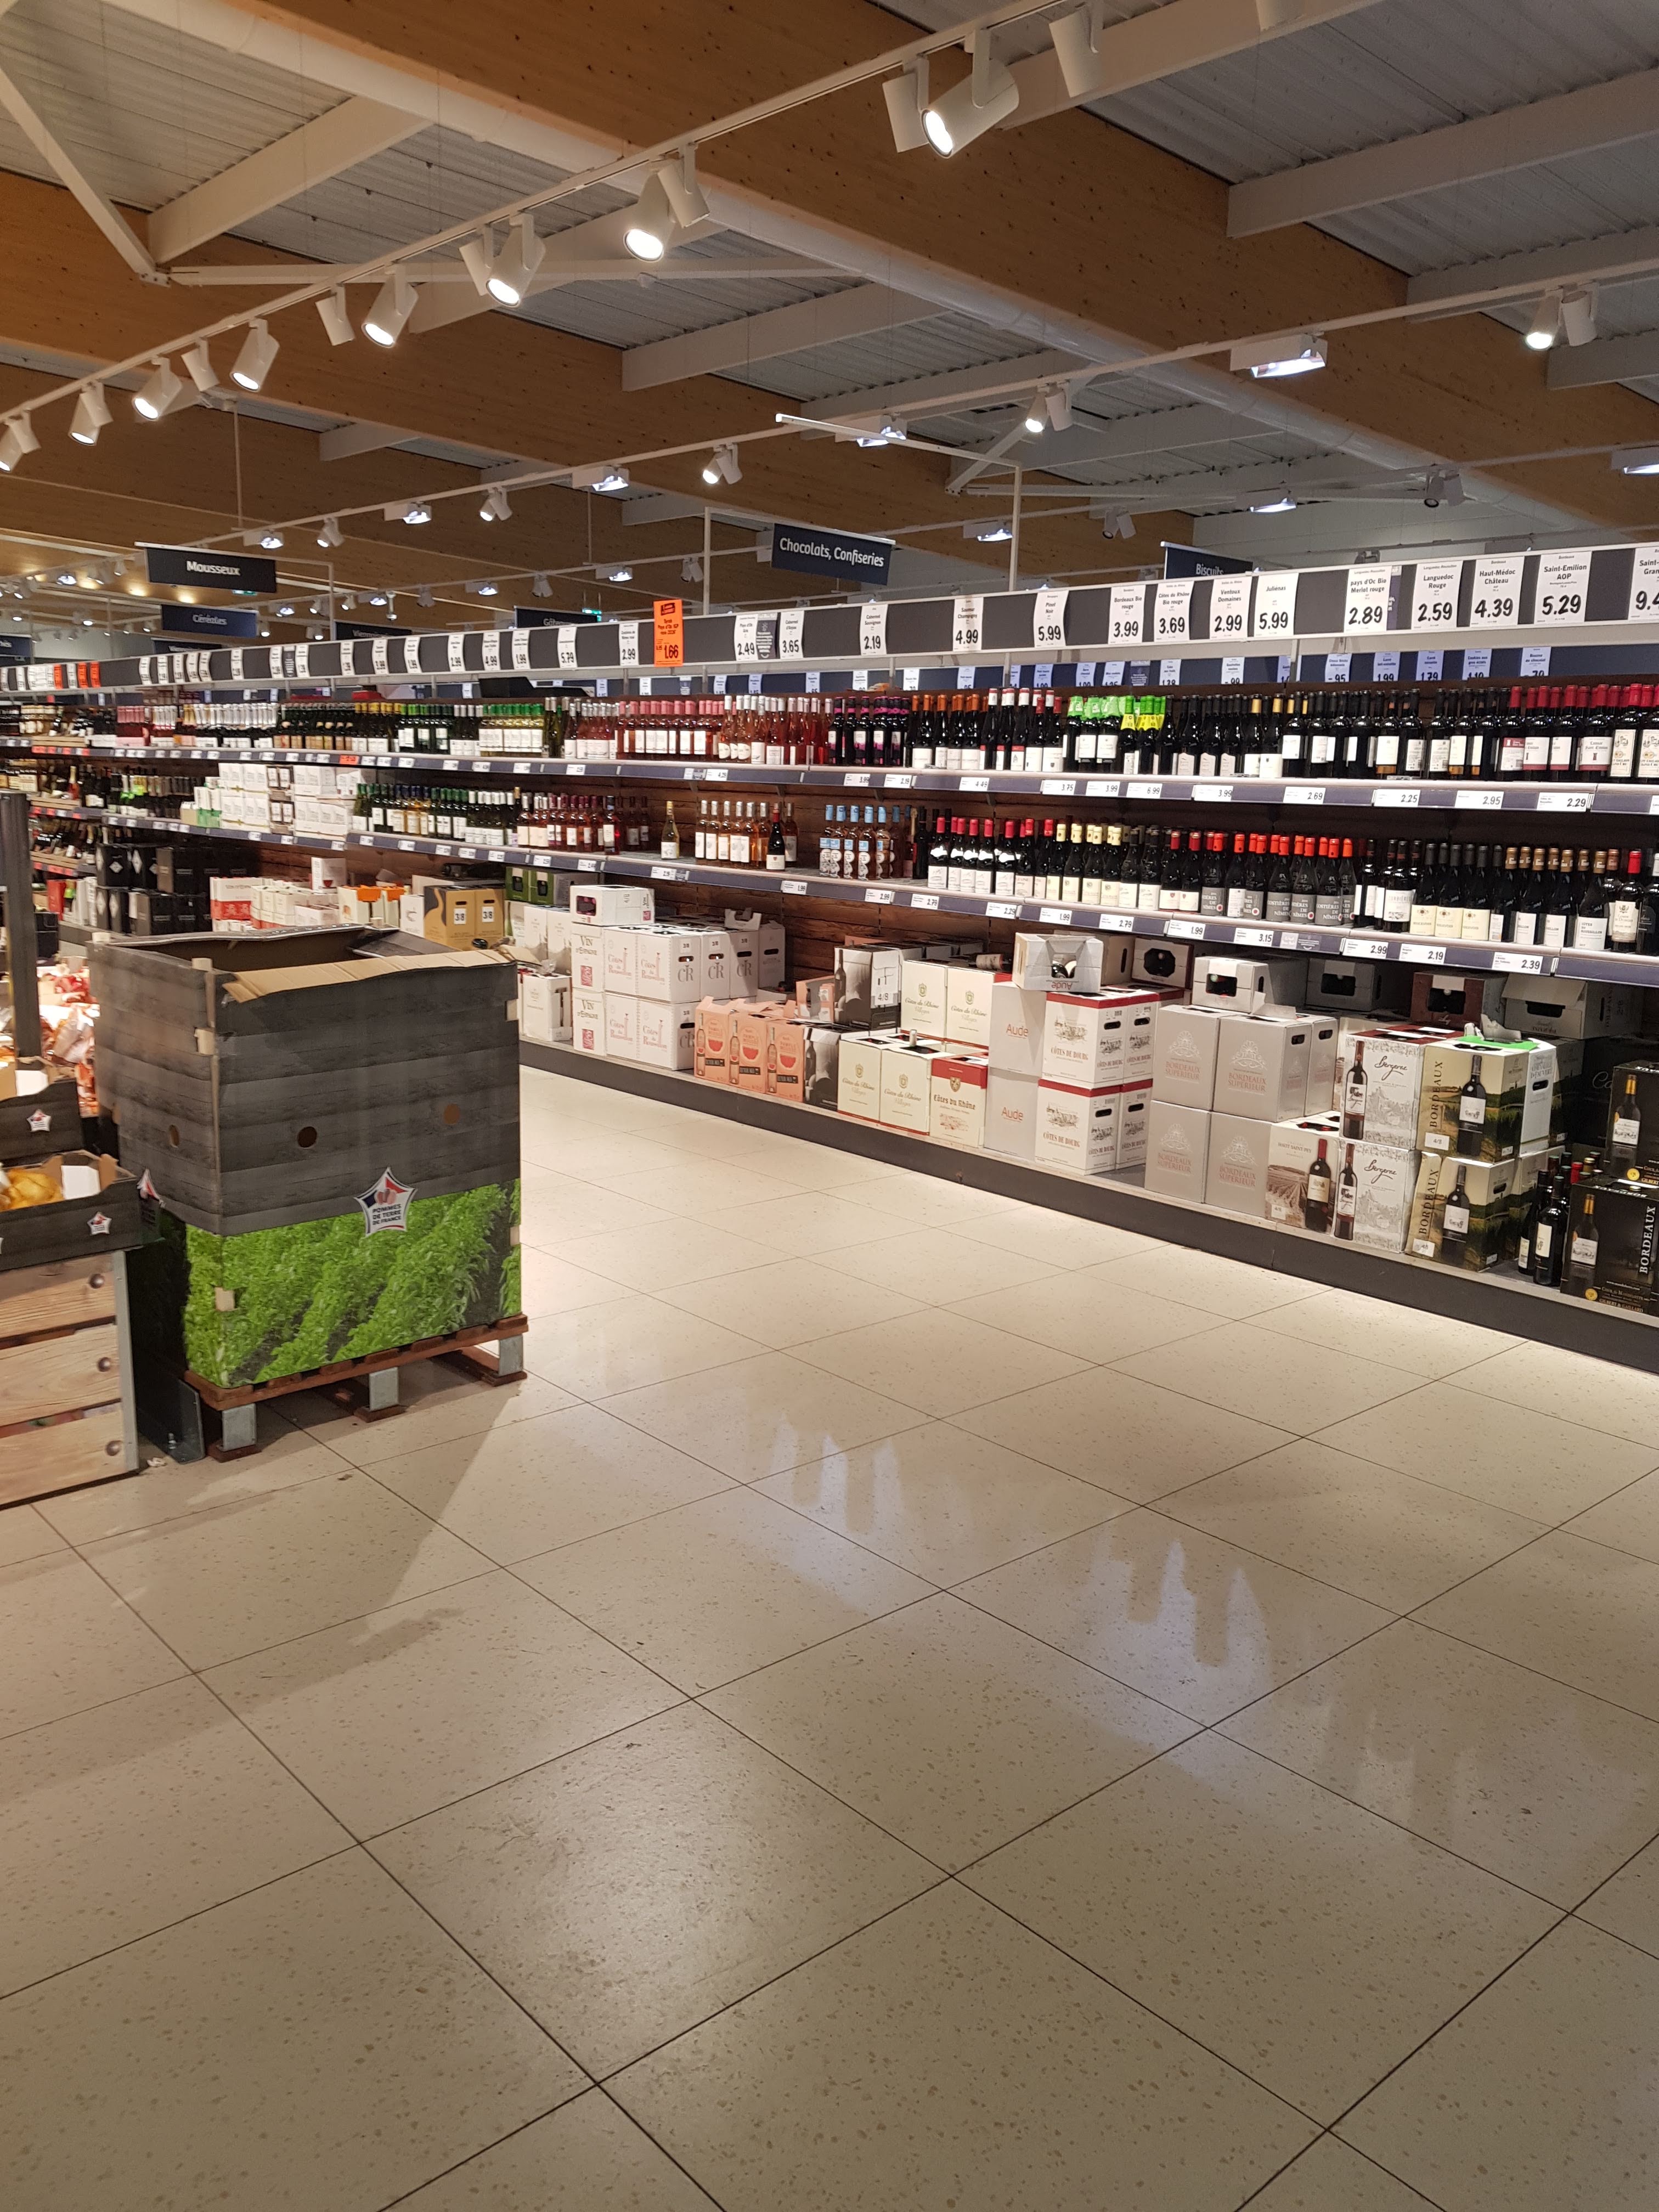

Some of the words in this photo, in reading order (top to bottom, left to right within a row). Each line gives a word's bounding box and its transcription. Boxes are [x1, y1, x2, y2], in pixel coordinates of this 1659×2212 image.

[780, 538, 832, 560] Chocolats,
[834, 547, 884, 567] Confiseries
[187, 561, 241, 576] Mousseux
[1544, 564, 1587, 573] Saint-Emilion
[1475, 598, 1513, 618] 4.39
[1542, 594, 1581, 615] 5.29
[1348, 606, 1383, 625] 2.89
[1418, 602, 1453, 622] 2.59
[1159, 617, 1185, 634] 3.69
[1215, 614, 1242, 632] 2.99
[1259, 612, 1288, 629] 5.99
[1038, 625, 1061, 641] 5.99
[1114, 621, 1138, 637] 3.99
[864, 635, 881, 650] 2.19
[955, 629, 979, 645] 4.99
[737, 642, 755, 656] 2.49
[782, 640, 799, 653] 3.65
[622, 648, 635, 660] 2.99
[1307, 792, 1323, 801] 2.69
[1401, 794, 1418, 803] 2.25
[1482, 796, 1501, 805] 2.95
[1567, 798, 1587, 808] 2.29
[580, 936, 593, 946] VIN
[1259, 934, 1272, 943] 3.15
[1370, 945, 1387, 955] 2.99
[1428, 951, 1443, 960] 2.19
[1521, 960, 1541, 969] 2.39
[1051, 981, 1073, 990] Aude
[878, 993, 889, 1001] 4/8
[582, 1000, 595, 1011] VIN
[1006, 1024, 1029, 1037] Aude
[1051, 1046, 1065, 1056] CÔTES
[1074, 1052, 1088, 1060] BOURG
[1166, 1061, 1200, 1074] BORDEAUX
[1374, 1056, 1407, 1081] Bergerac
[1228, 1073, 1266, 1085] BORDEAUX
[1429, 1061, 1443, 1128] BORDEAUX
[934, 1094, 948, 1104] Côtes
[950, 1098, 957, 1106] du
[958, 1099, 976, 1110] Rhône
[1001, 1107, 1023, 1121] Aude
[1043, 1132, 1058, 1142] CÔTES
[1065, 1137, 1080, 1147] BOURG
[1220, 1165, 1256, 1179] BORDEAUX
[1364, 1159, 1397, 1184] Bergerac
[373, 1204, 400, 1213] POMMES
[1419, 1169, 1439, 1234] BORDEAUX
[381, 1216, 401, 1224] FRANCE
[383, 1210, 401, 1218] TERRE
[1639, 1206, 1656, 1274] BORDEAUX
